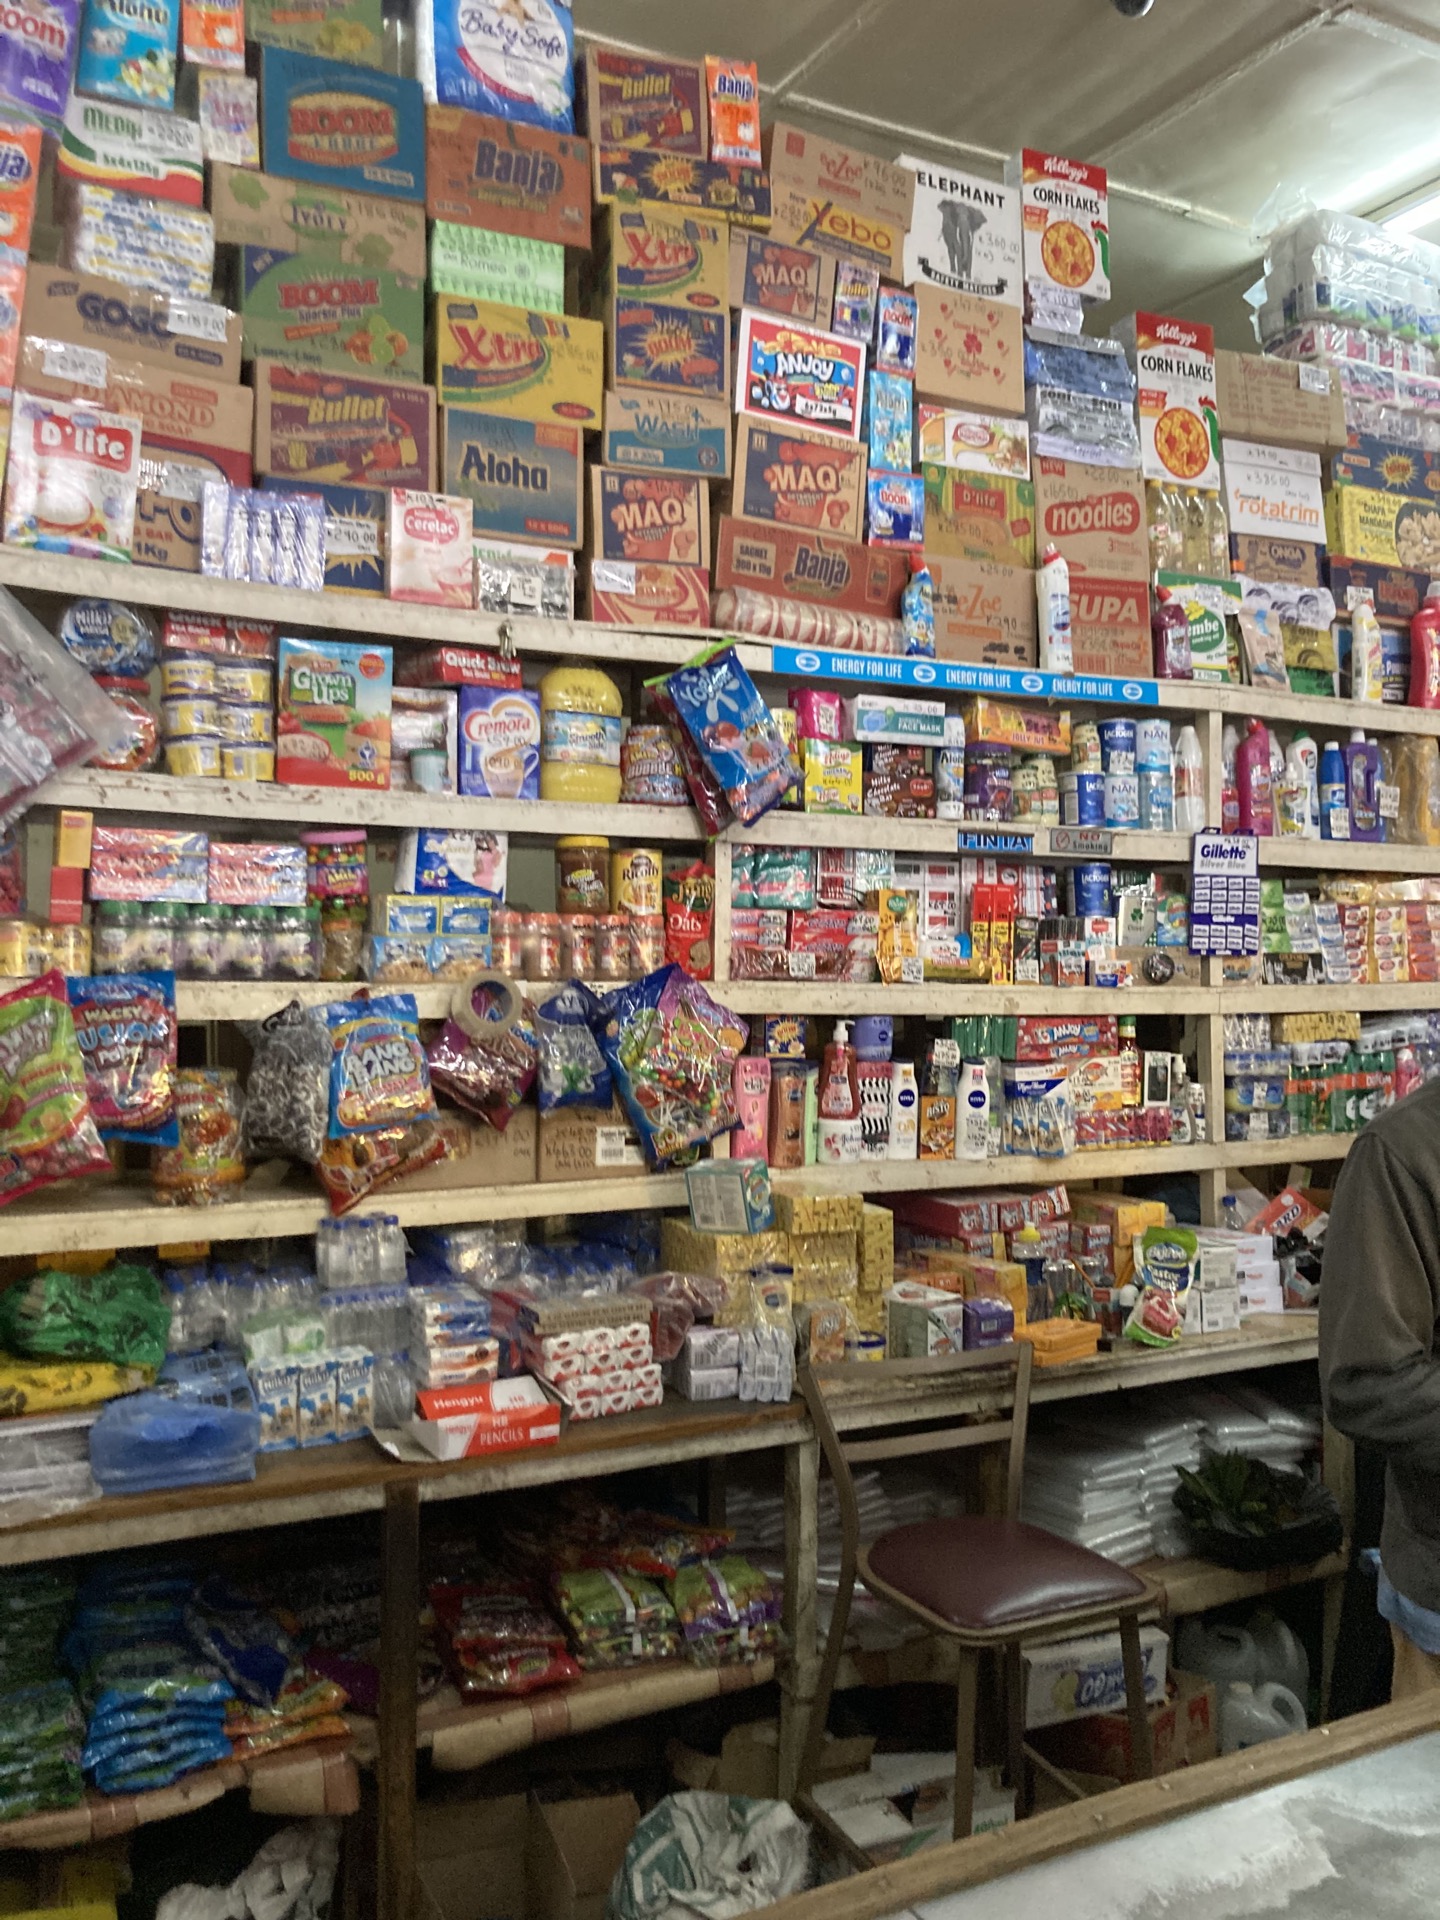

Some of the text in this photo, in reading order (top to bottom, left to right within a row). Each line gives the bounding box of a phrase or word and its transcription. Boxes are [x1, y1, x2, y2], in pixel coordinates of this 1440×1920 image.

[0, 6, 66, 49] oom
[461, 8, 516, 56] Baby
[717, 74, 755, 100] Banja
[289, 106, 391, 136] BOOM
[474, 139, 562, 195] Banja
[1043, 157, 1089, 182] Kellogg's
[917, 170, 1006, 209] ELEPHANT
[1033, 186, 1101, 216] CORN FLAKES
[809, 201, 892, 252] Yebo
[279, 281, 378, 310] BOOM
[450, 323, 542, 369] Xtra
[1156, 322, 1198, 346] Kellogg's
[776, 353, 835, 381] ANJOY
[1140, 354, 1214, 383] CORN FLAKES
[307, 395, 385, 424] Bullet
[41, 418, 125, 460] D'lite
[461, 443, 548, 491] Aloha
[770, 465, 840, 494] MAQ
[617, 497, 685, 533] MAQ
[1238, 494, 1319, 524] rotatrim
[405, 517, 455, 535] Cerelac
[794, 547, 848, 588] Banja
[446, 652, 486, 671] Quick
[831, 660, 902, 679] ENERGY FOR LIFE
[292, 667, 352, 692] Grown
[946, 669, 1012, 688] ENERGY FOR LIFE
[1052, 677, 1114, 697] ENERGY FOR LIFE
[314, 687, 350, 706] Ups
[465, 710, 531, 742] Cremora
[897, 722, 942, 734] FACE MASK
[940, 752, 965, 765] Aloh
[866, 784, 901, 799] Chocolate
[1111, 785, 1137, 794] NAN
[963, 833, 1027, 849] FINTA
[1072, 840, 1109, 852] Smoking
[1078, 833, 1100, 841] NO
[1199, 860, 1226, 869] Silver
[1200, 844, 1247, 861] Gillette
[670, 913, 703, 932] Oats
[85, 1005, 143, 1022] WACKY
[76, 1021, 171, 1050] USION
[1053, 1023, 1082, 1041] ANJOY
[479, 1428, 525, 1446] PENCILS
